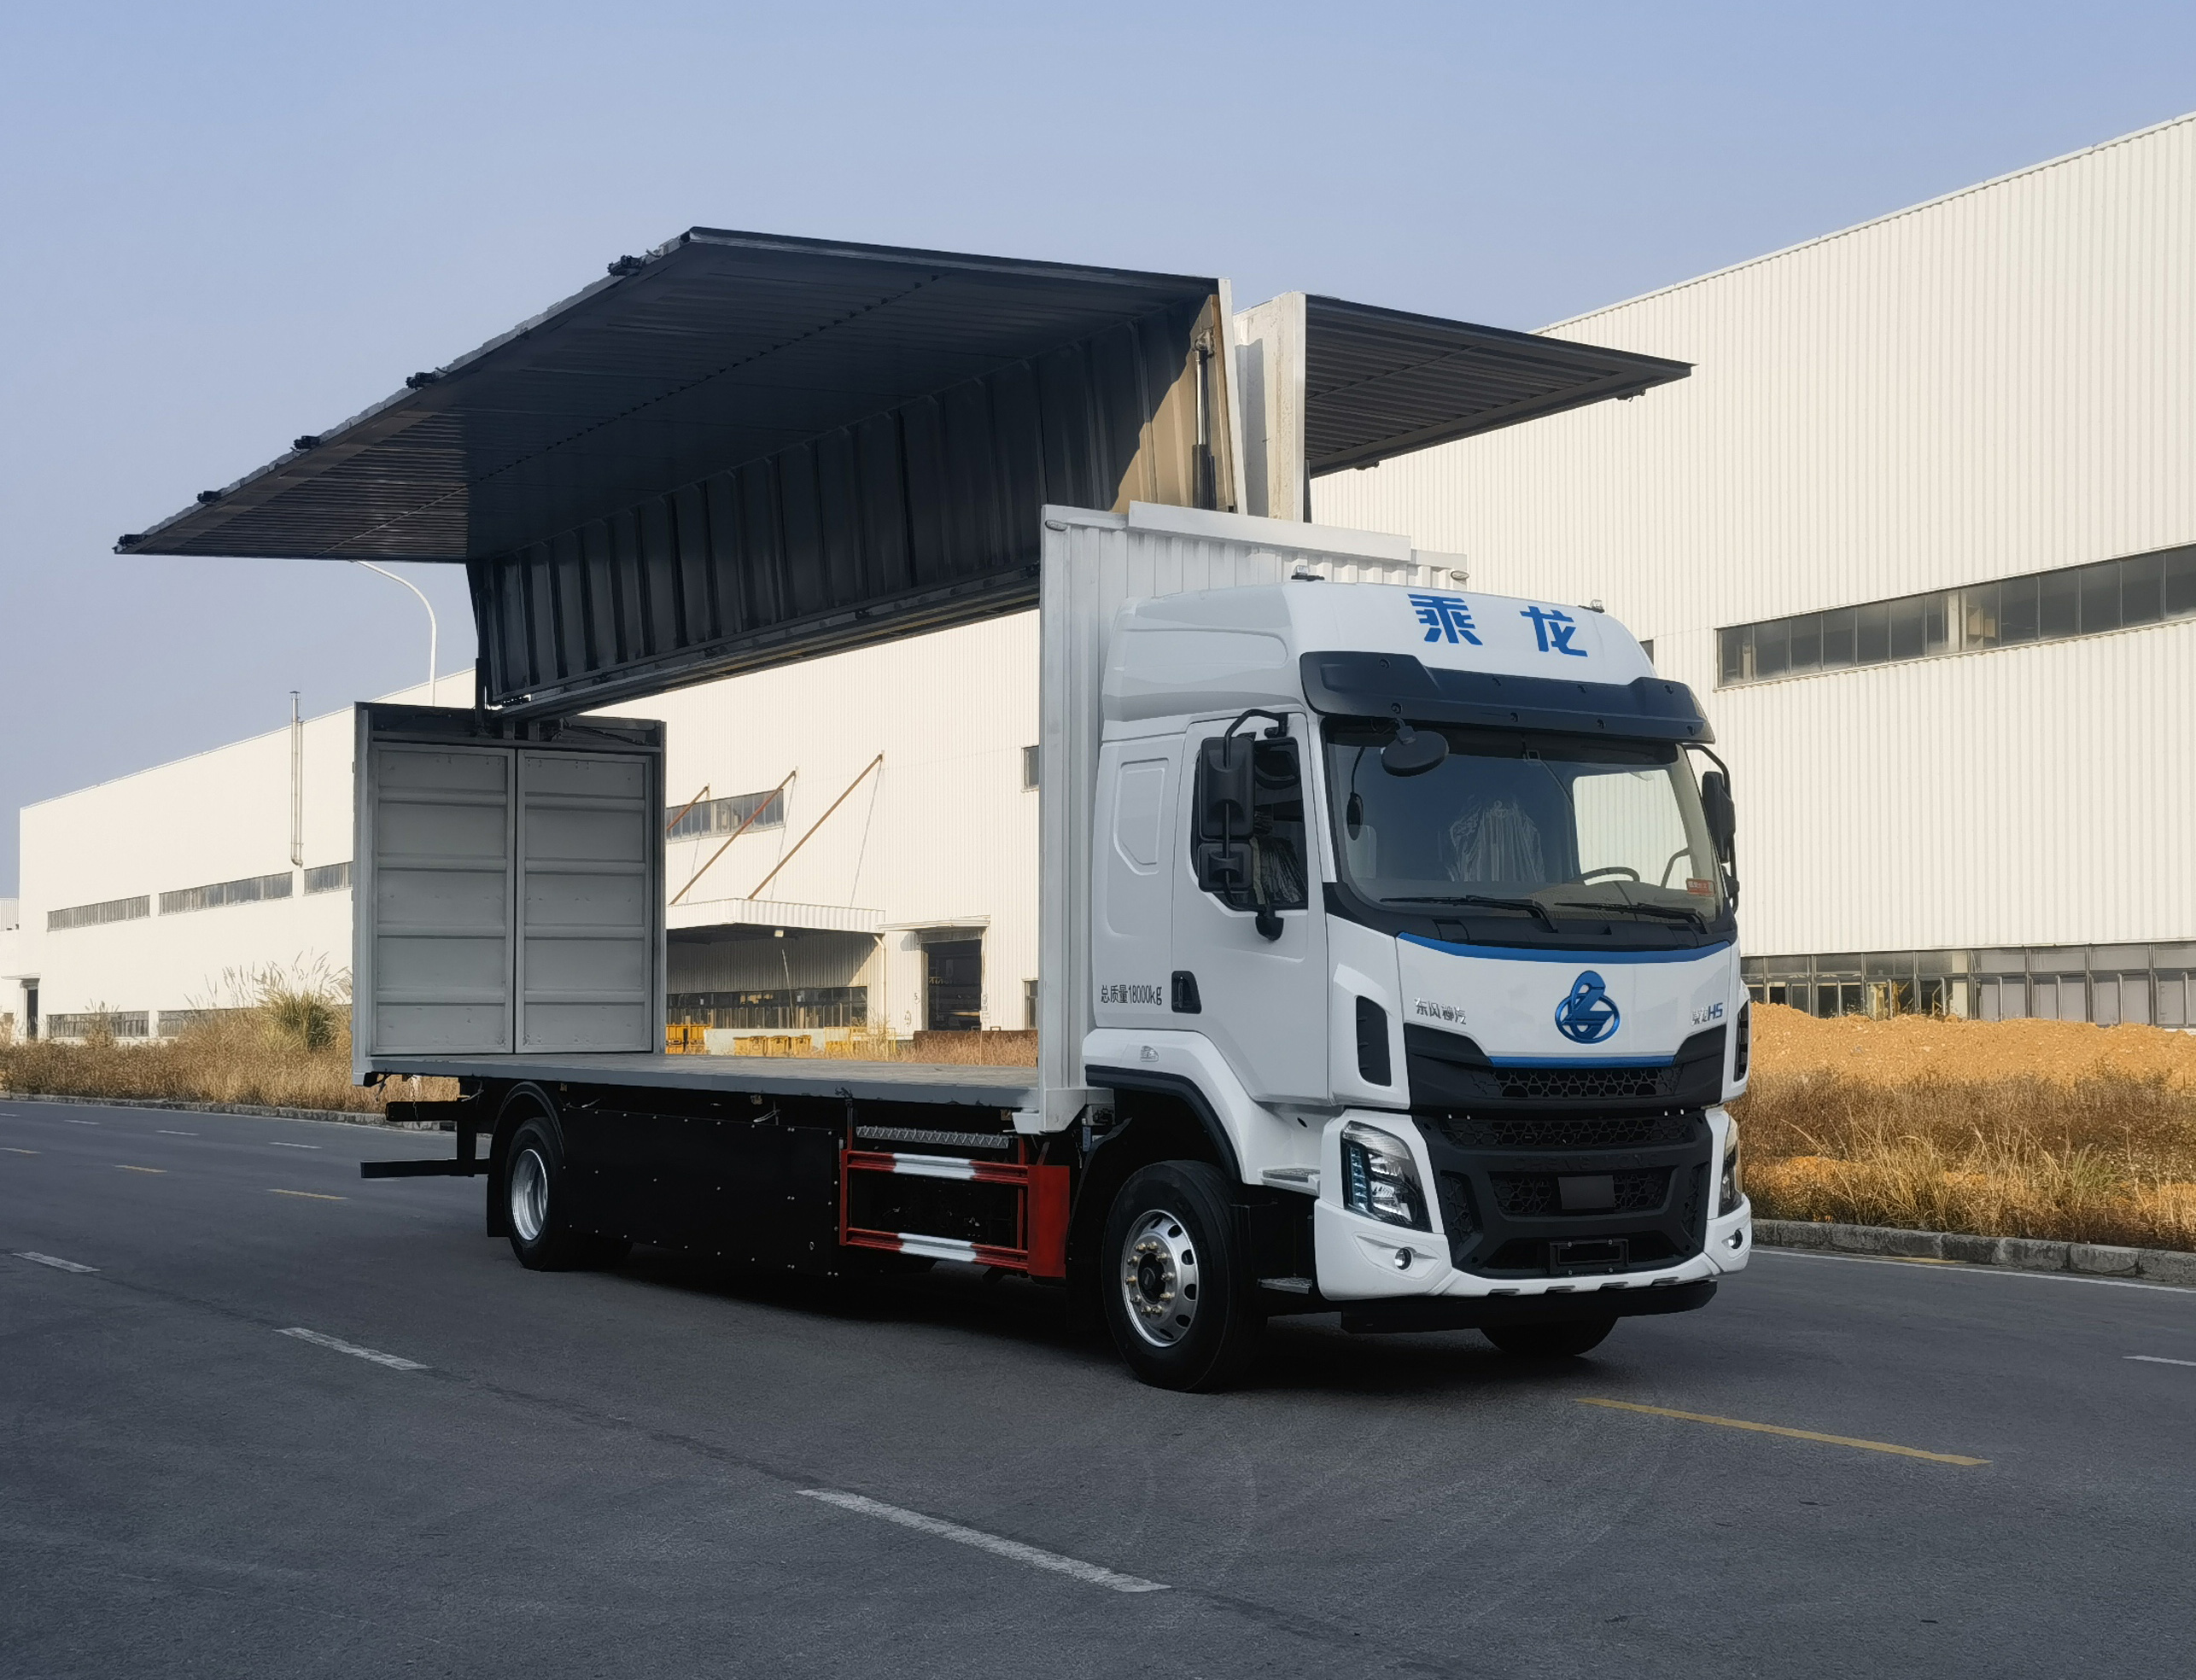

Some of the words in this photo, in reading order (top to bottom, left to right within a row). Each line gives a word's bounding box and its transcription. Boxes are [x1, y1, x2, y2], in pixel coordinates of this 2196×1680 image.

[1407, 593, 1588, 657] 乘龙
[1101, 984, 1162, 1006] 总质量18000kg
